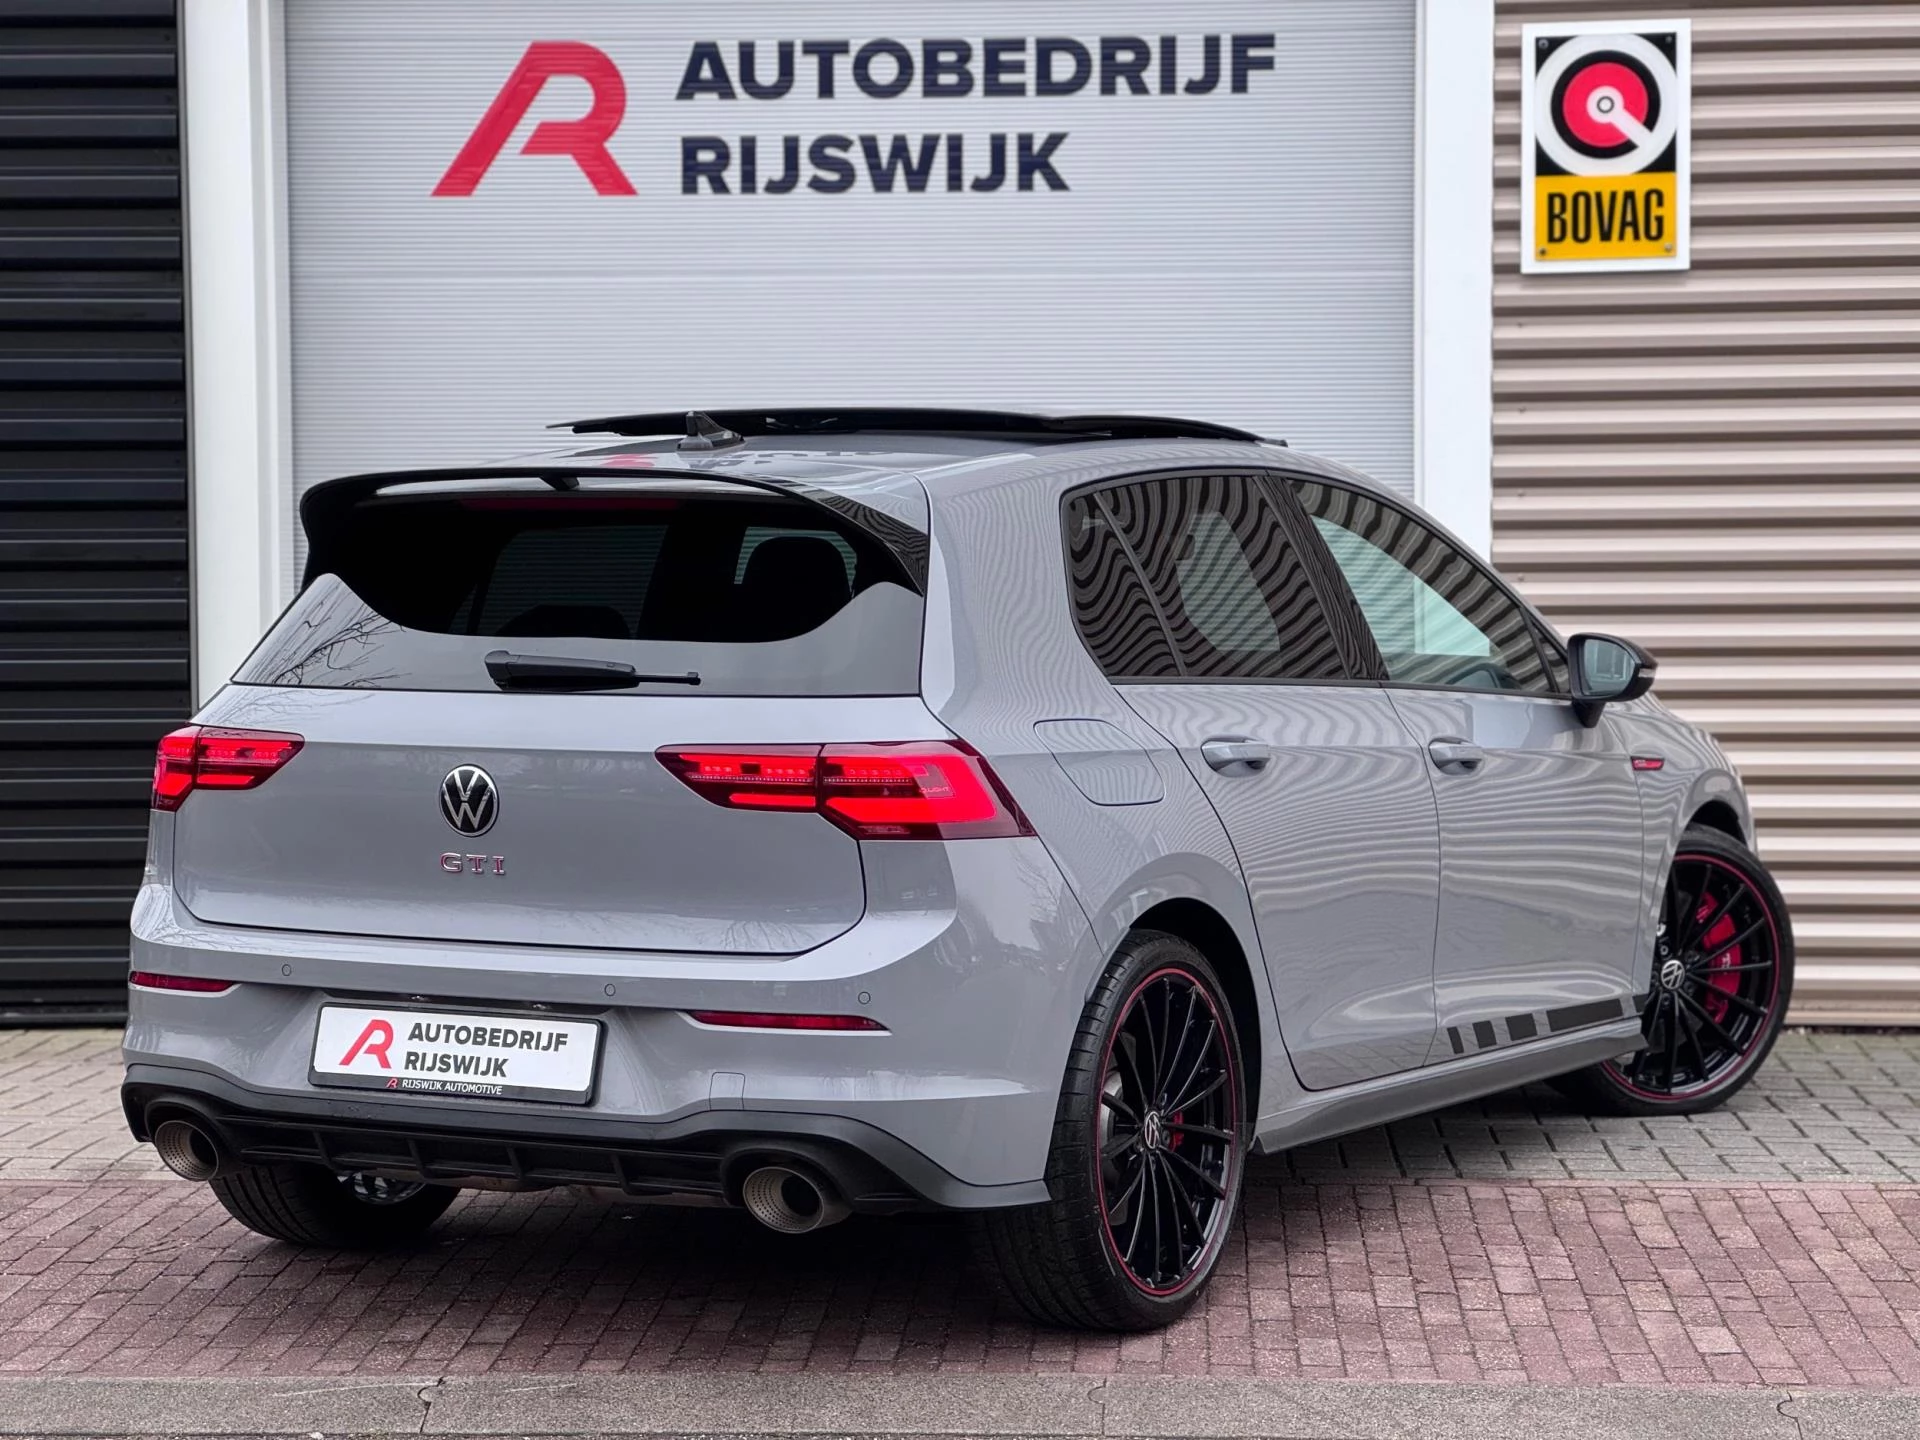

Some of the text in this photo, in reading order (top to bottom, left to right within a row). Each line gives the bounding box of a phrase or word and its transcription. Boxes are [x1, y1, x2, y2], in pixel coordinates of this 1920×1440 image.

[676, 33, 1276, 101] AUTOBEDRIJF
[681, 132, 1070, 195] RIJSWIJK
[1547, 188, 1665, 244] BOVAG
[440, 852, 505, 875] GTI
[408, 1022, 568, 1052] AUTOBEDRIJF
[404, 1051, 509, 1078] RIJSWIJK
[402, 1079, 502, 1095] RIJSWIJK AUTOMOTIVE
